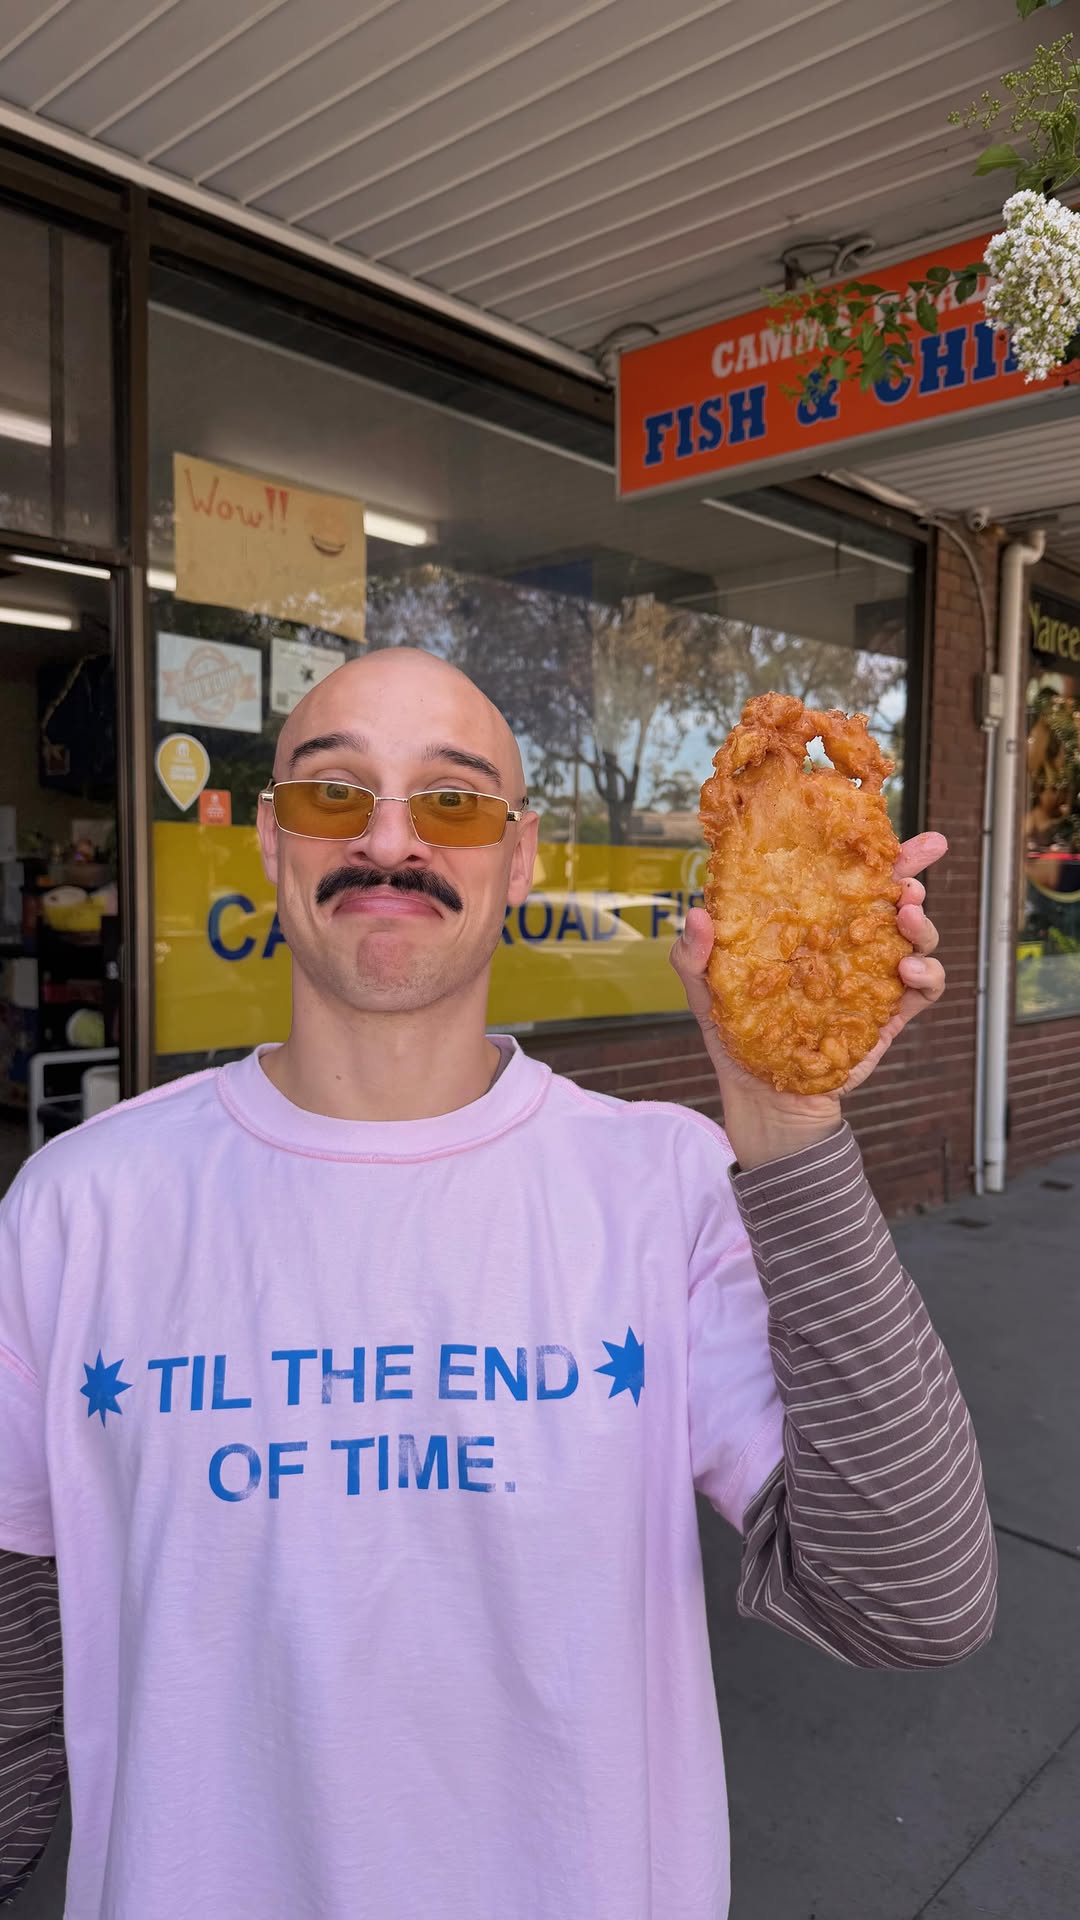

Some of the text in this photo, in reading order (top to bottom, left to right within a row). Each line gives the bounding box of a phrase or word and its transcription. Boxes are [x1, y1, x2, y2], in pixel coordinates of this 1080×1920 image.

[643, 320, 1024, 468] FISH & CHI
[147, 1343, 580, 1413] TIL THE END
[208, 1433, 517, 1502] OF TIME.
